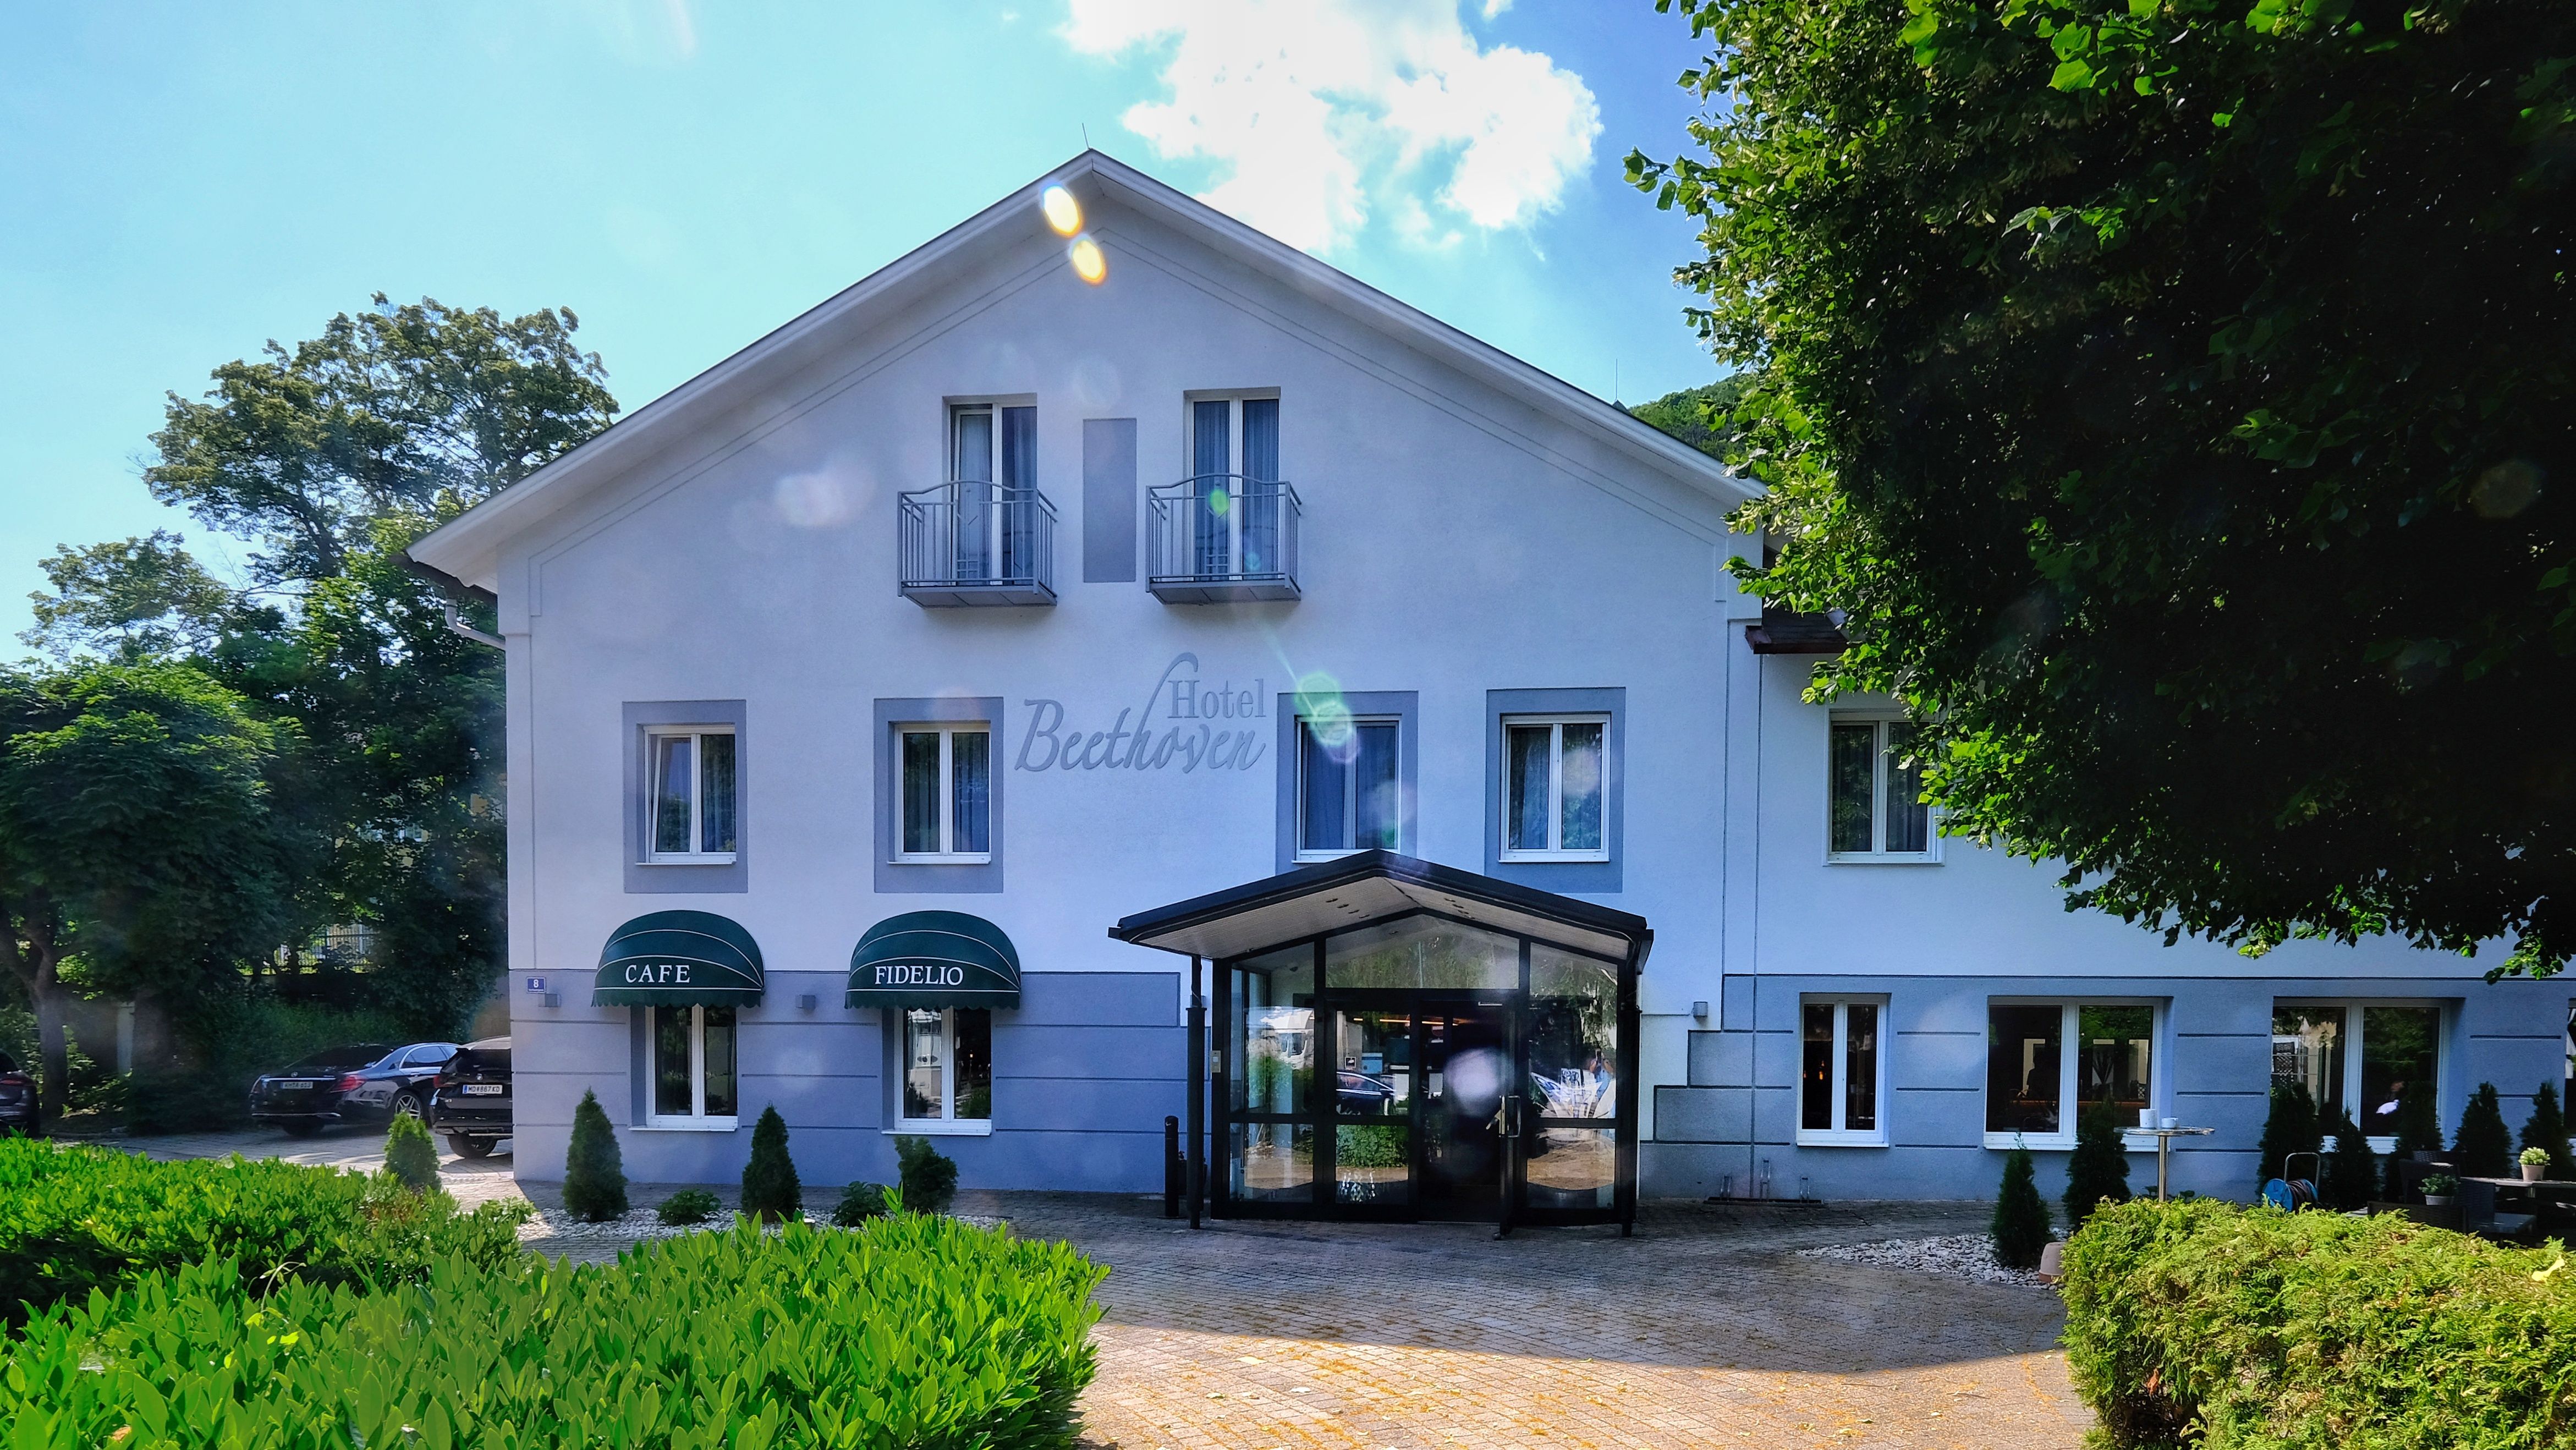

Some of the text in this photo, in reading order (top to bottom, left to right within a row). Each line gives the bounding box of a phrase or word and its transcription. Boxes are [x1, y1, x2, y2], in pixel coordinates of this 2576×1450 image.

[1167, 678, 1266, 719] Hotel
[1014, 652, 1266, 773] Beethoven
[534, 979, 539, 988] 8
[625, 964, 690, 983] CAFE
[875, 965, 963, 986] FIDELIO
